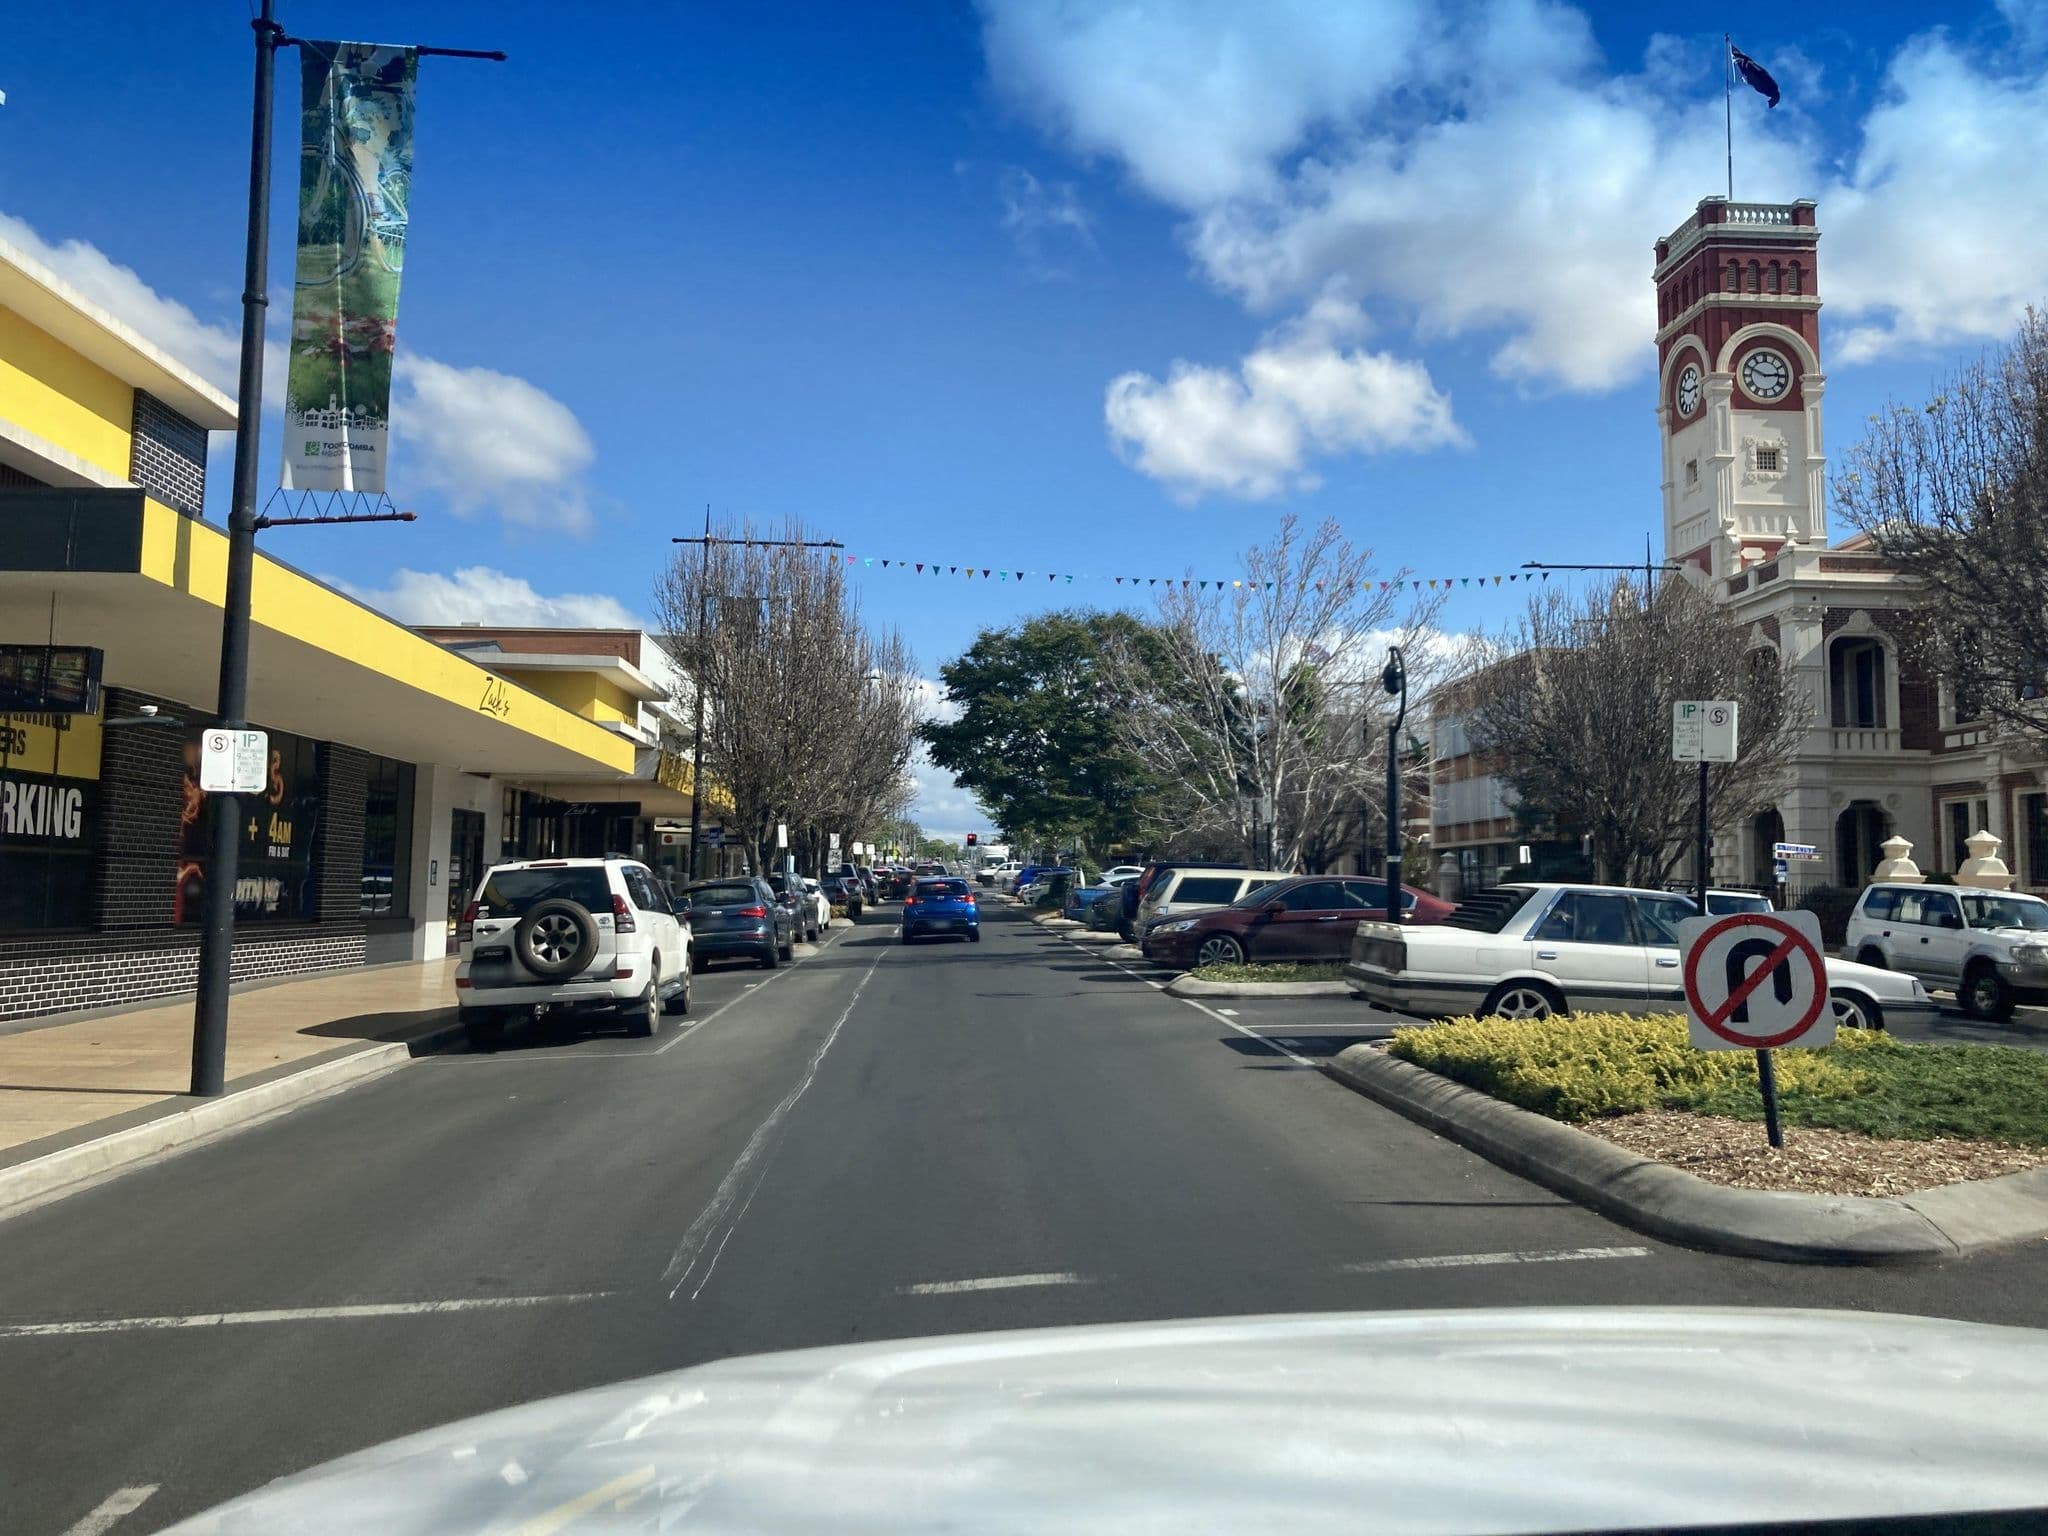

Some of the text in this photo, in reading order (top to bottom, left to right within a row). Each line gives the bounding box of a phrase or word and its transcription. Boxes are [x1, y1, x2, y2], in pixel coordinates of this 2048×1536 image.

[1682, 704, 1696, 719] 1P
[242, 733, 258, 748] 1P
[0, 781, 82, 838] RKING
[269, 812, 292, 844] 4AM
